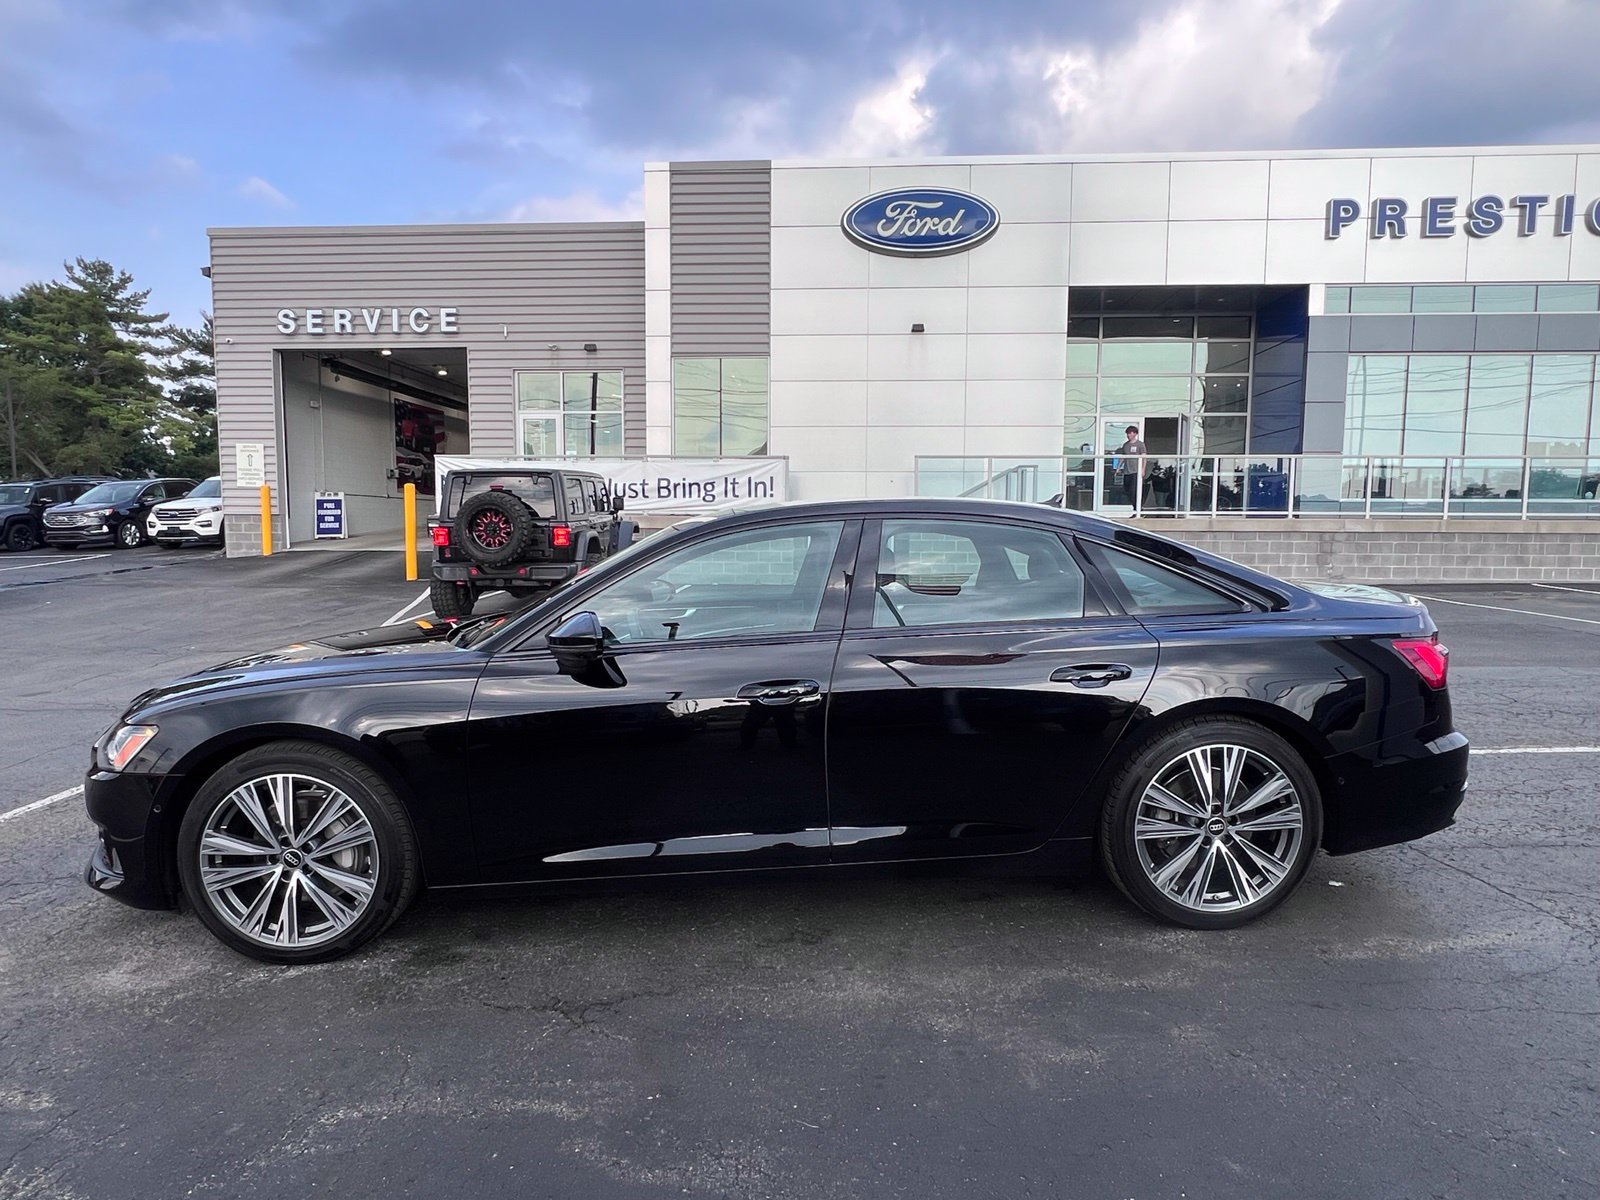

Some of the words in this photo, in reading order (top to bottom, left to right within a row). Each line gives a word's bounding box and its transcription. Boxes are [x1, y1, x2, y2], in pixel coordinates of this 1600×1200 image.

[876, 200, 966, 238] Ford
[1325, 193, 1600, 240] PRESTI
[277, 307, 460, 335] SERVICE
[608, 478, 650, 499] Just
[657, 477, 716, 503] Bring
[723, 476, 739, 498] It
[747, 475, 775, 498] In!
